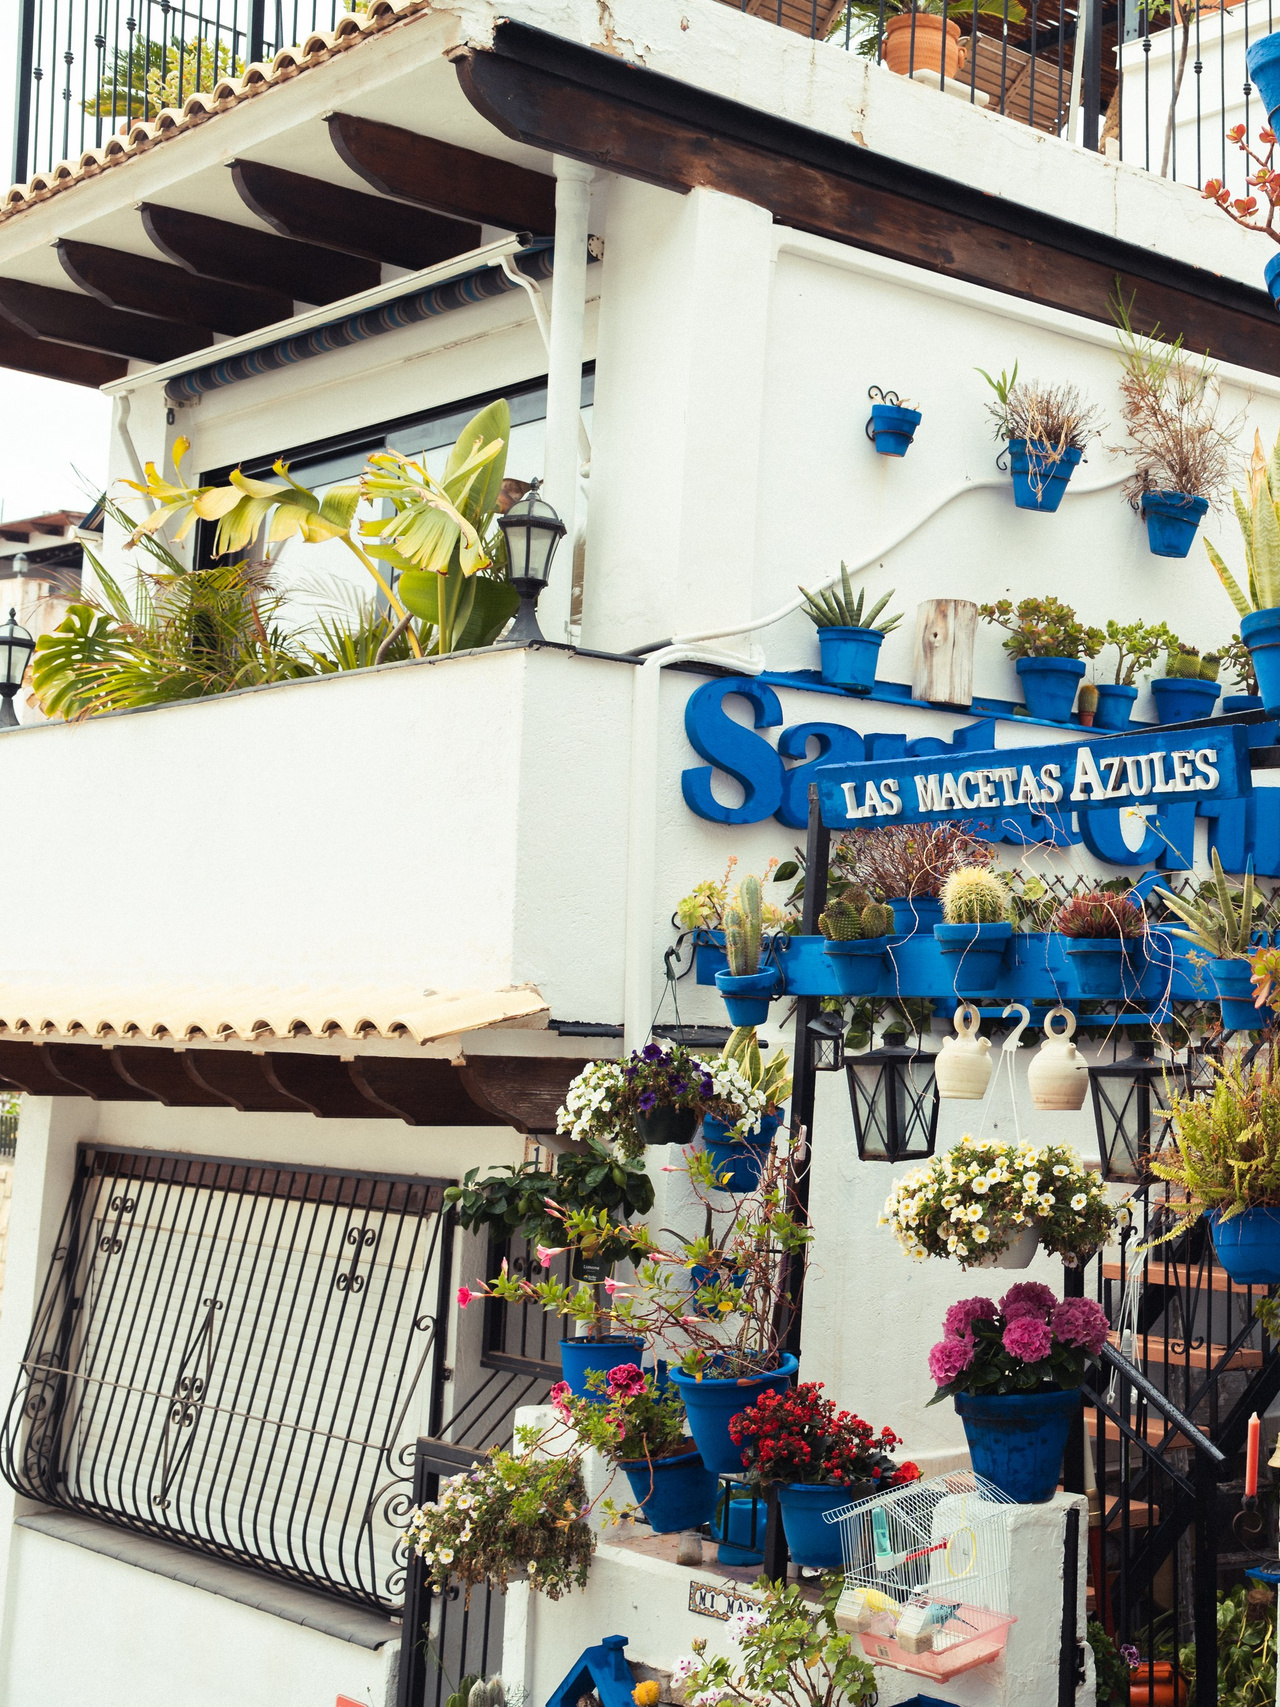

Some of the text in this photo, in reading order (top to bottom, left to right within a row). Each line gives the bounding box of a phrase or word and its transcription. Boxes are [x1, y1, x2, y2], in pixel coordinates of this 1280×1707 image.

[841, 747, 1221, 819] LAS MACETAS AZULES
[699, 1591, 715, 1609] MI
